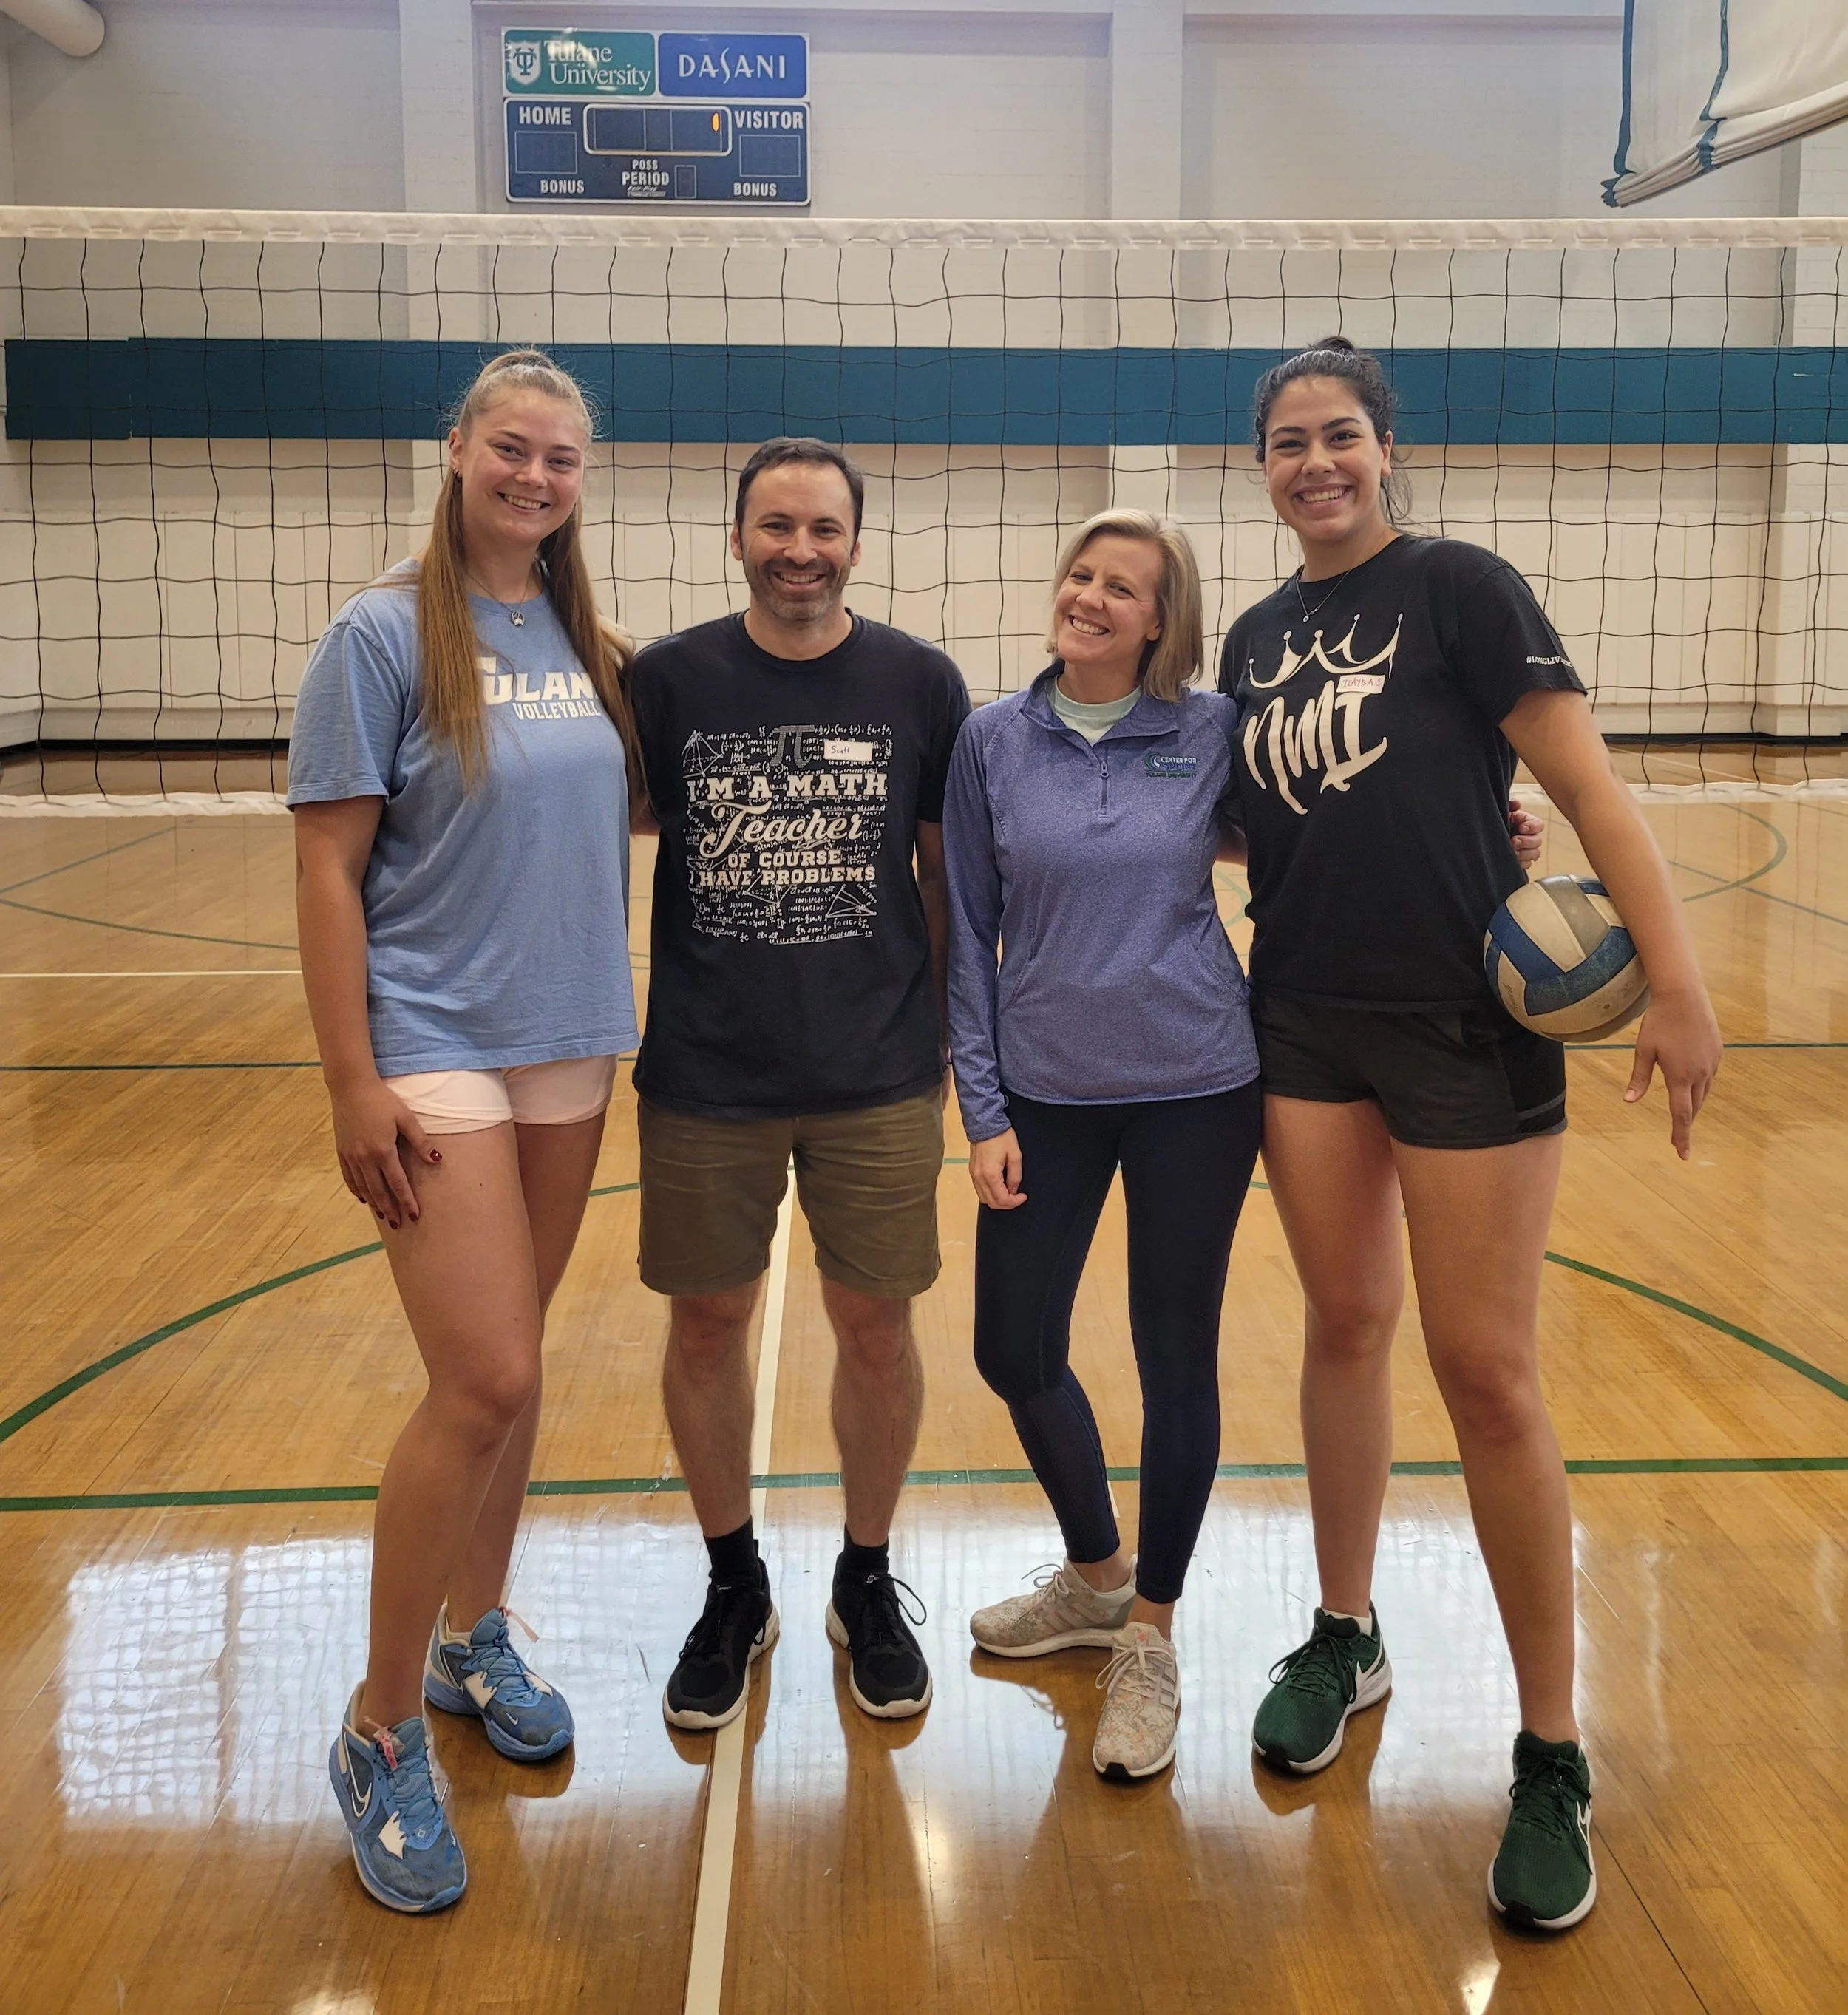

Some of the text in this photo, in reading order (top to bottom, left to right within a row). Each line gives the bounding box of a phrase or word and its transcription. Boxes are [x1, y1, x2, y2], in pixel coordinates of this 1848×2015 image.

[543, 40, 613, 62] Tulane
[679, 47, 785, 84] DASANI
[548, 62, 651, 92] University
[519, 107, 571, 125] HOME
[734, 111, 804, 129] VISITOR
[632, 159, 658, 171] POSS
[540, 180, 585, 194] BONUS
[621, 171, 670, 186] PERIOD
[733, 182, 777, 197] BONUS
[477, 656, 599, 705] ULAN
[512, 700, 600, 720] VOLLEYBALL
[748, 775, 773, 799] A
[786, 773, 888, 798] MATH
[699, 800, 863, 859] Teacher
[727, 849, 841, 869] OF COURSE
[699, 869, 753, 887] HAVE
[760, 866, 876, 886] PROBLEMS
